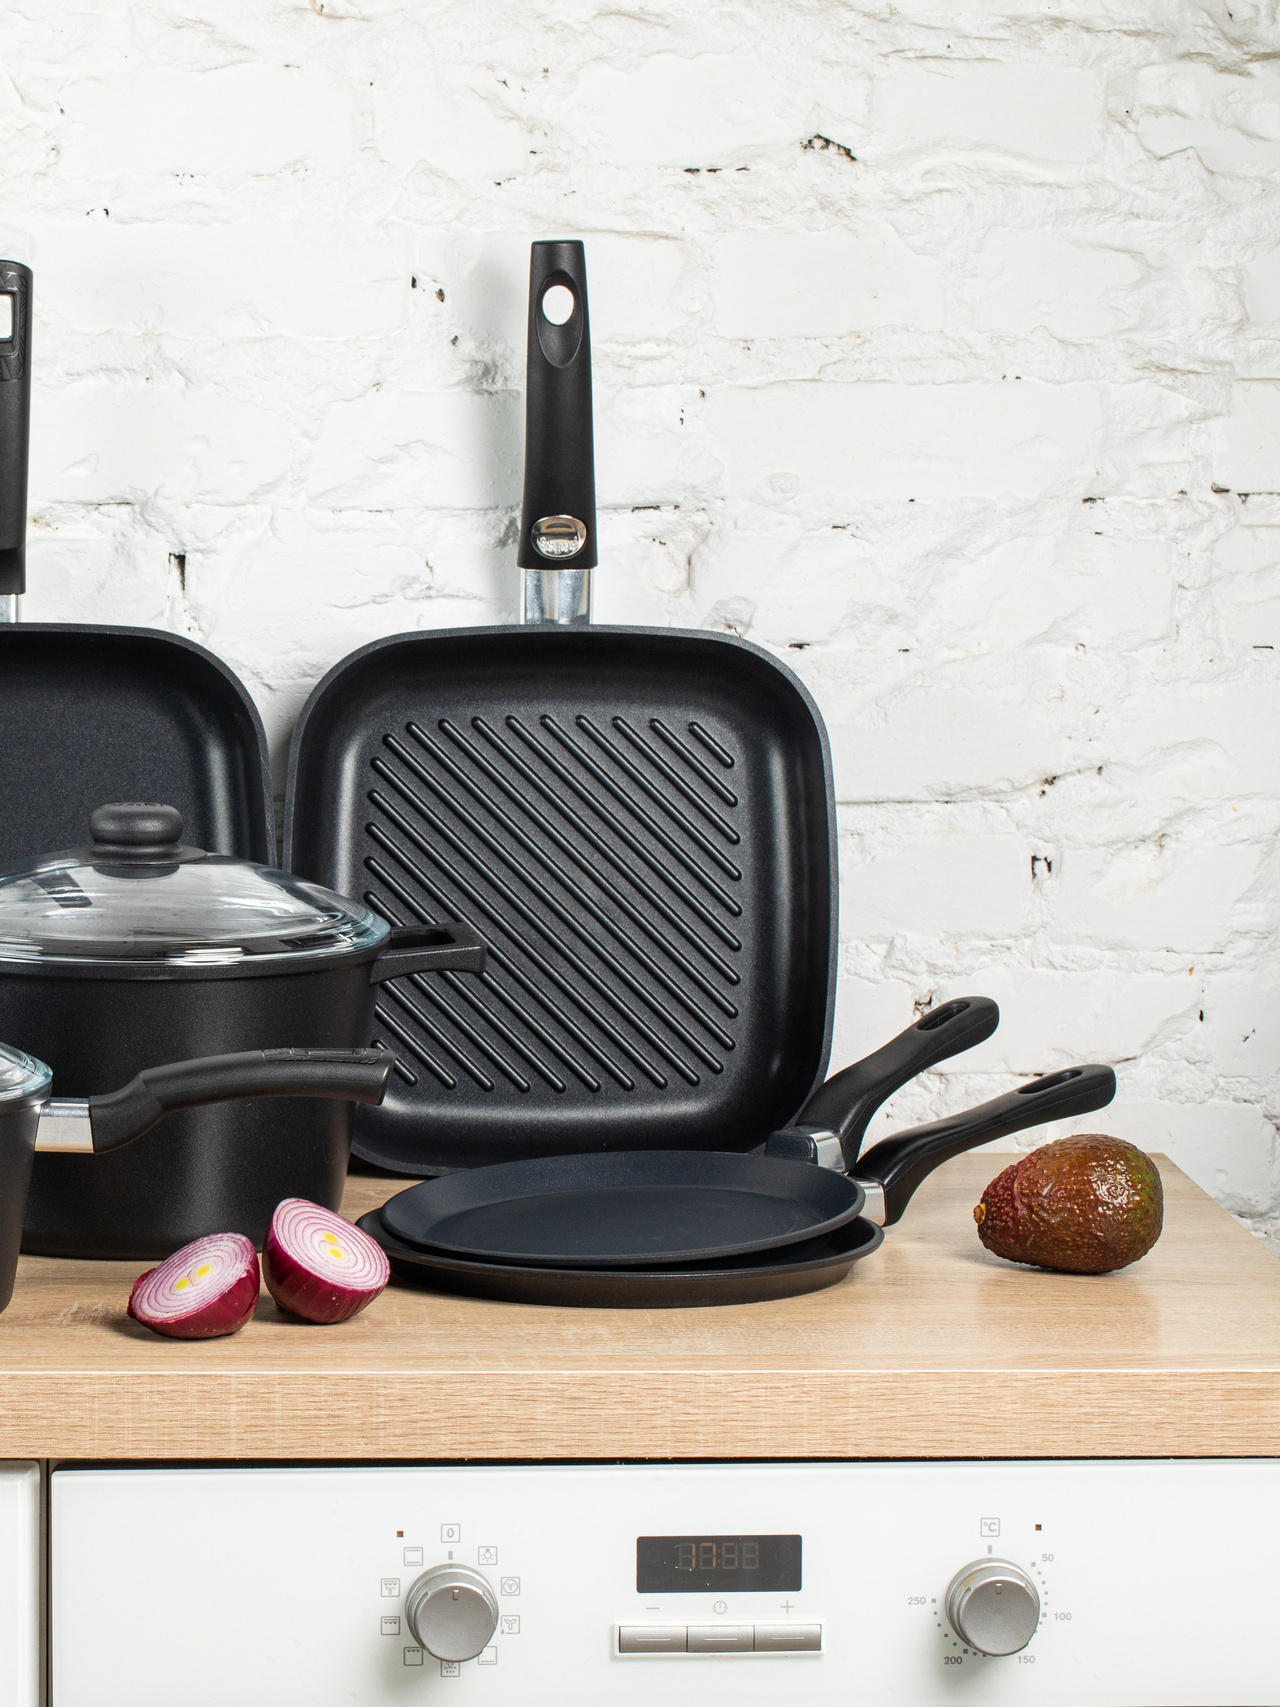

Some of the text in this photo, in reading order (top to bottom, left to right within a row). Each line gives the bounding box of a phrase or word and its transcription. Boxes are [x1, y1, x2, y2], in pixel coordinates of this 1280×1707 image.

[1042, 1553, 1055, 1562] 50
[907, 1596, 926, 1606] 250
[1053, 1612, 1072, 1621] 100
[943, 1656, 963, 1665] 200
[1017, 1655, 1036, 1664] 150
